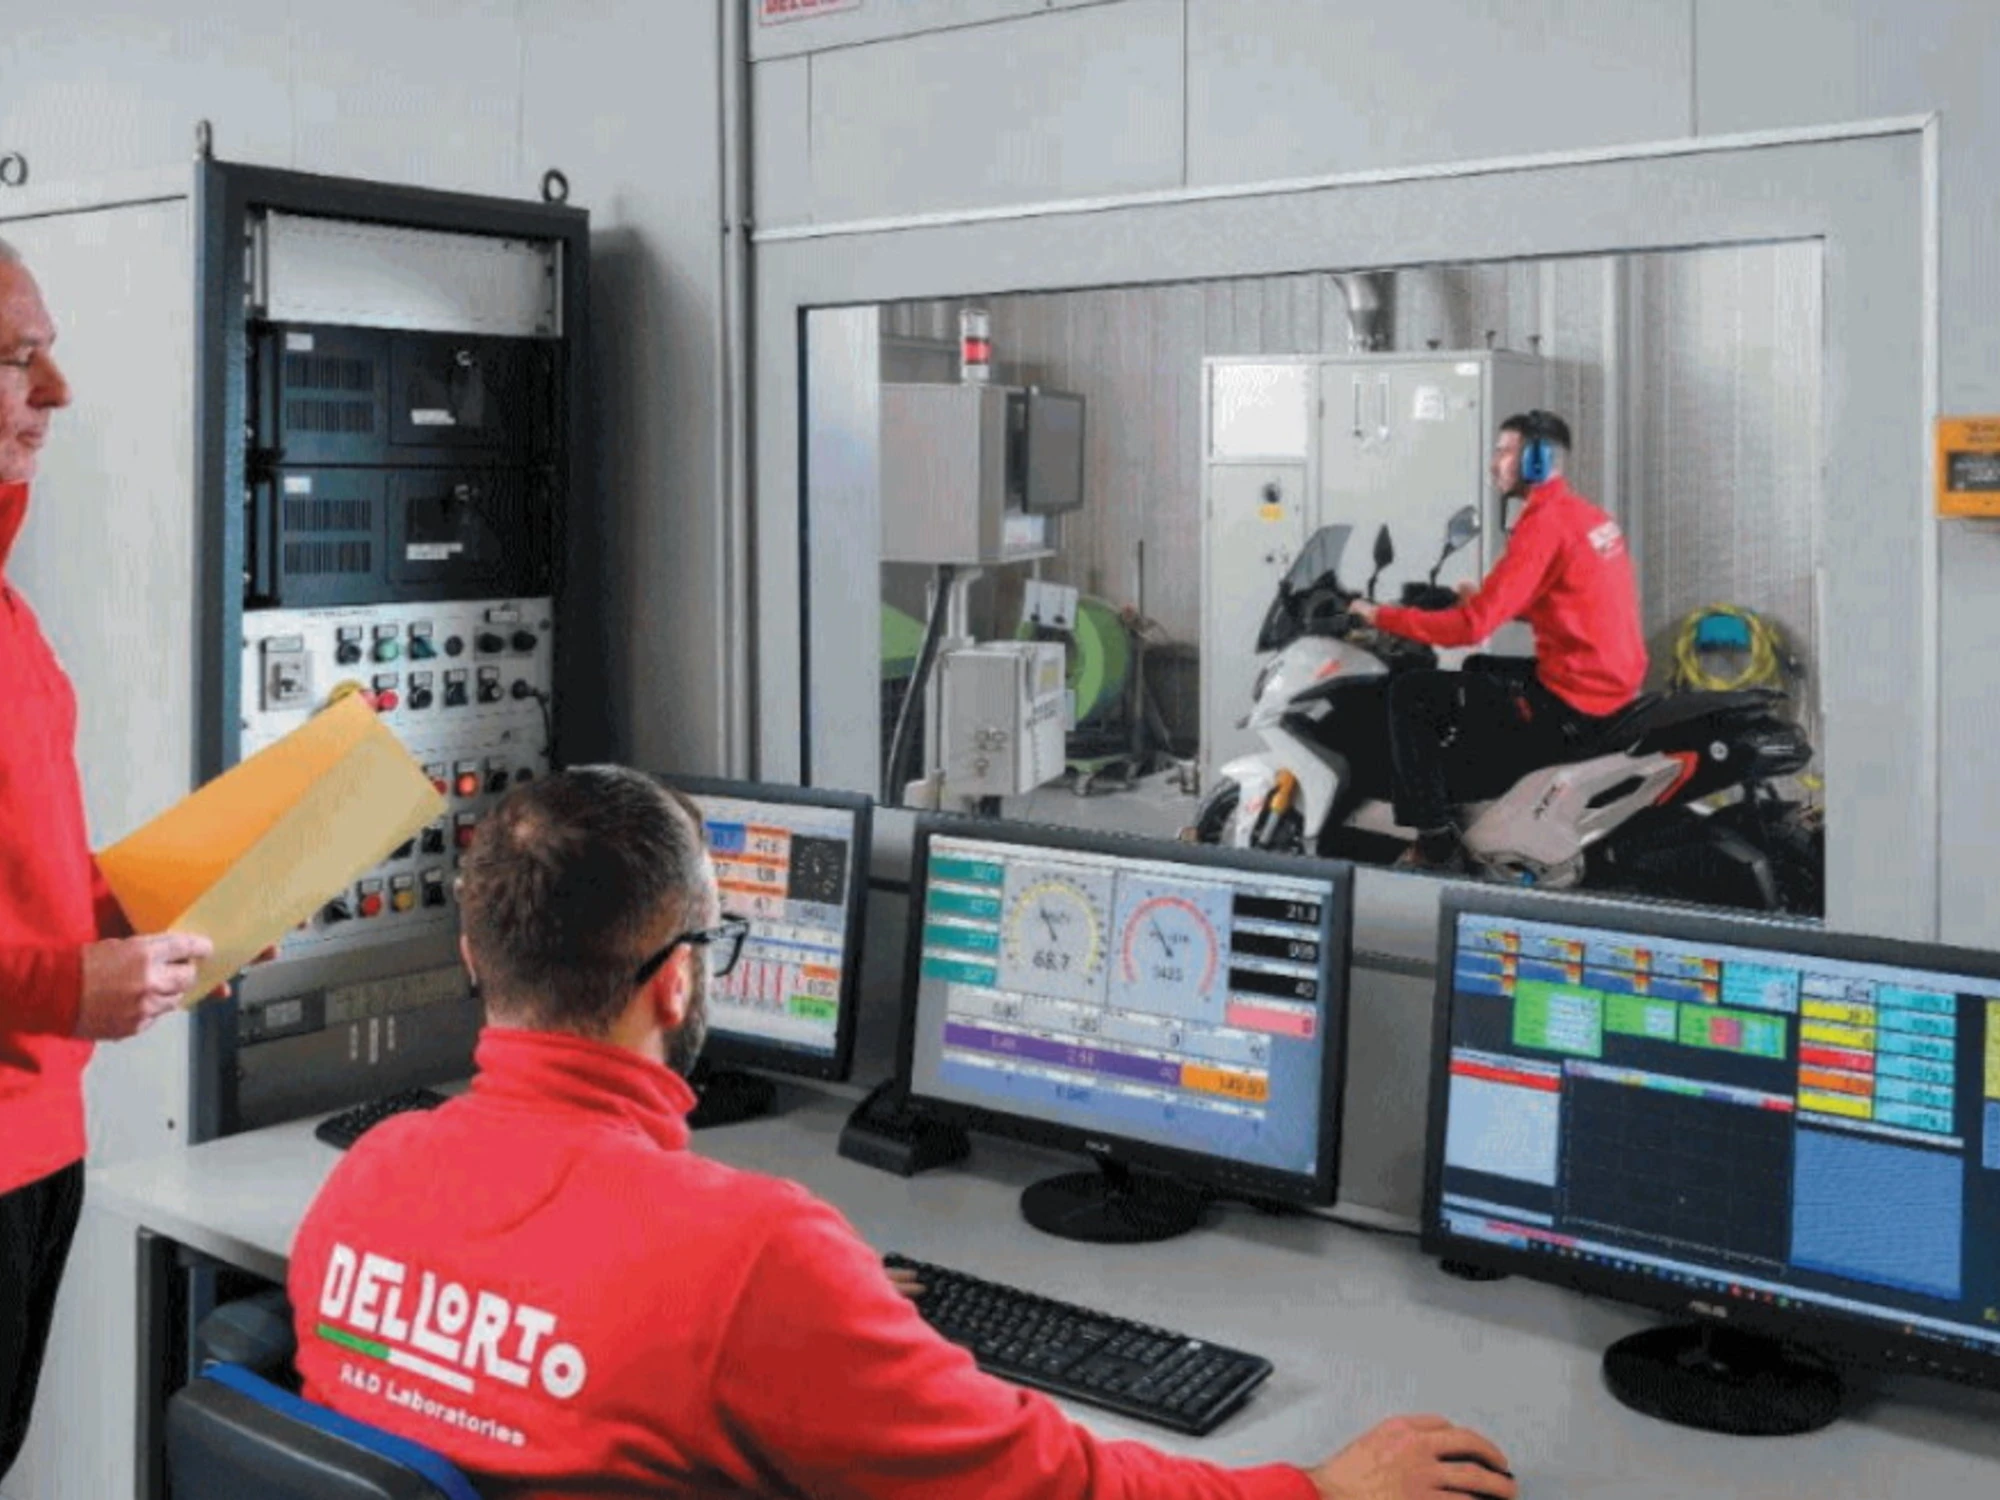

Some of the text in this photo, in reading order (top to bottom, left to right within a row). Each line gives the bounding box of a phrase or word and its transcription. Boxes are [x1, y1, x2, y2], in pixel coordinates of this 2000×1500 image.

[318, 1243, 587, 1400] DELLORTO
[340, 1363, 527, 1447] R&D Laboratories
